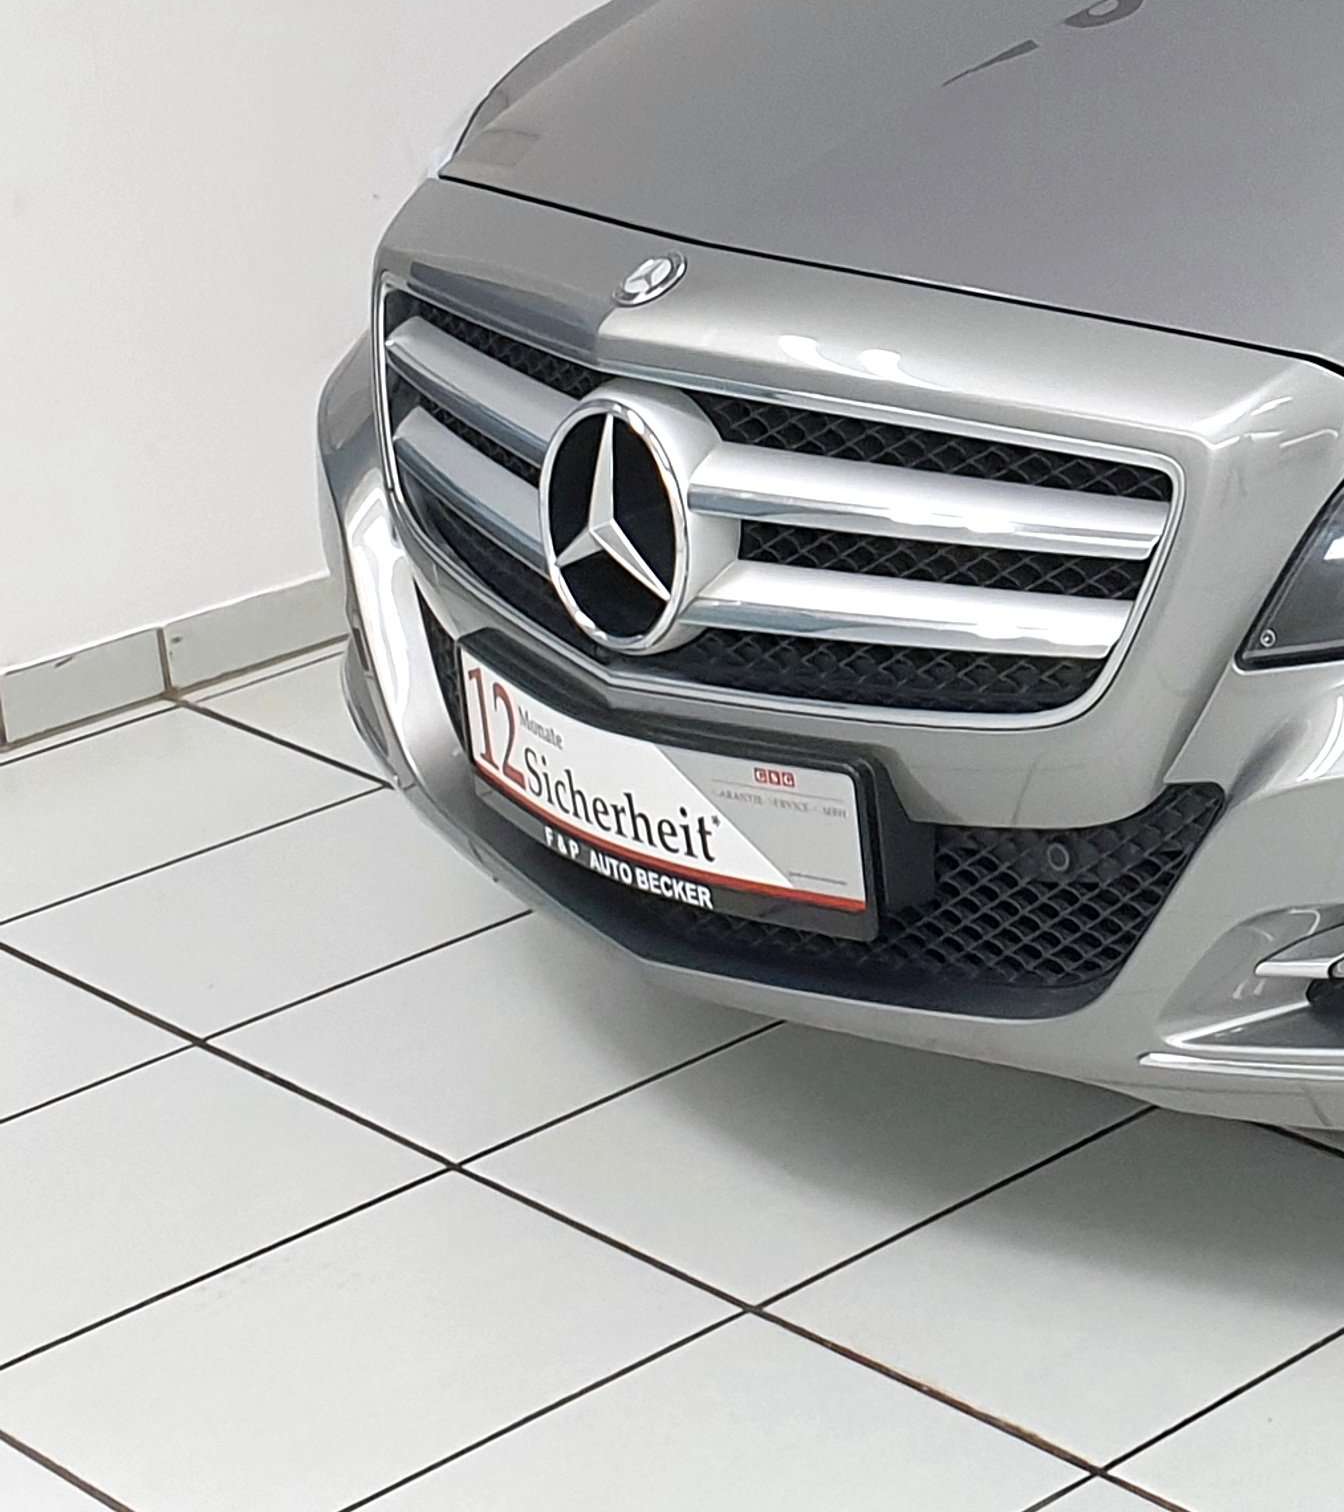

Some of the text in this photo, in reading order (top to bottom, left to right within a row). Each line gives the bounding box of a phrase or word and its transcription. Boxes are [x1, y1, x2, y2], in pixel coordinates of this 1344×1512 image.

[468, 668, 526, 790] 12
[518, 706, 564, 749] Monate
[590, 851, 633, 885] AUTO
[635, 869, 714, 910] BECKER
